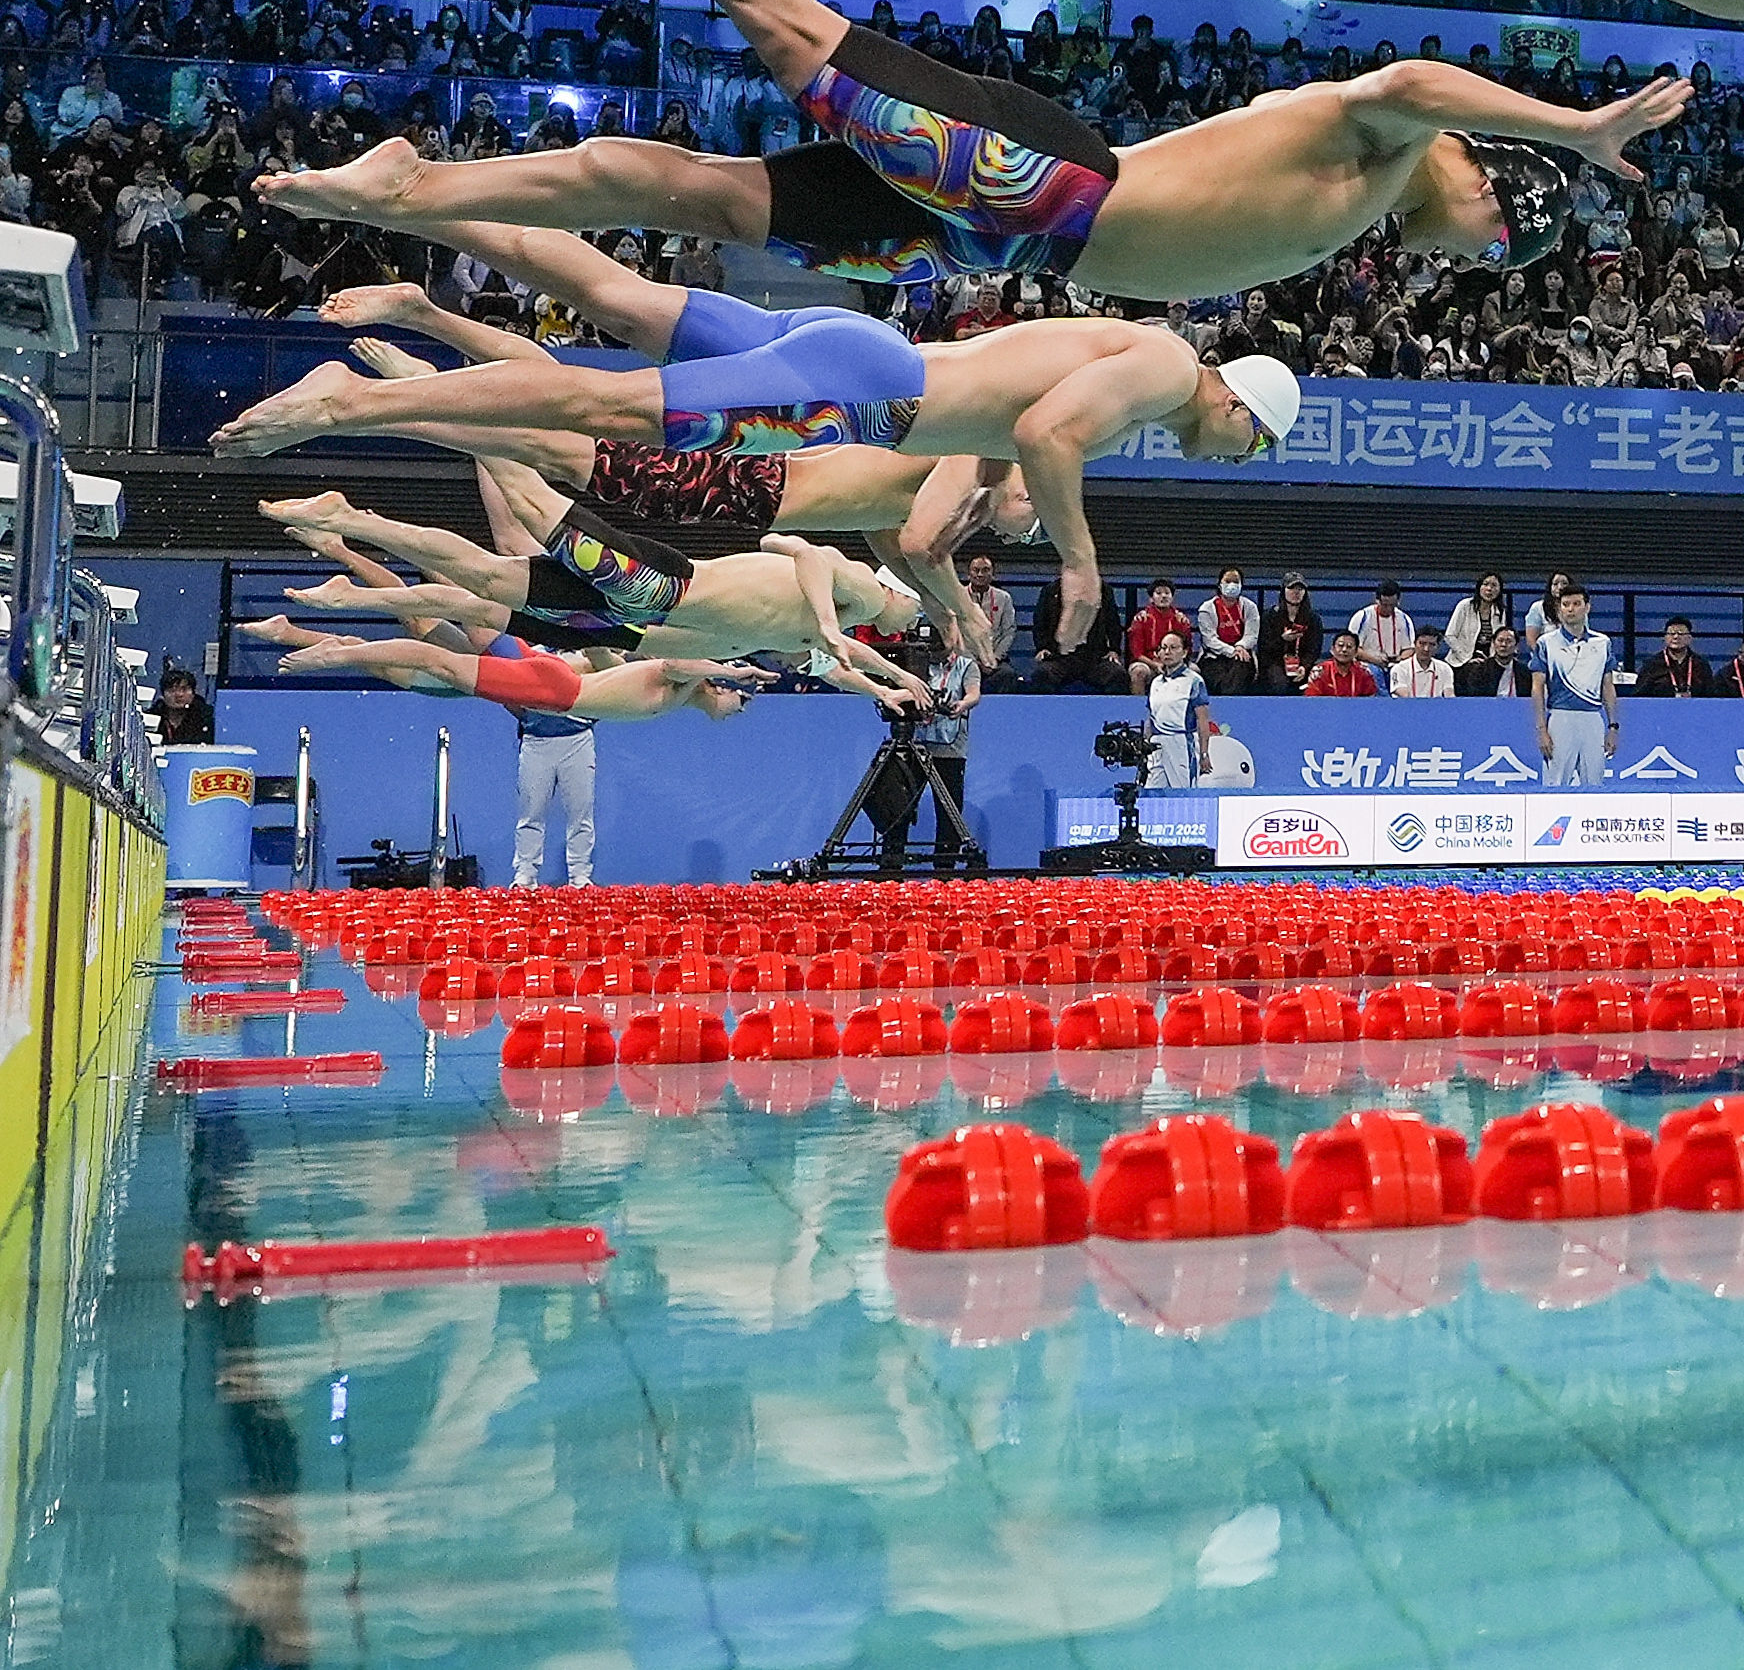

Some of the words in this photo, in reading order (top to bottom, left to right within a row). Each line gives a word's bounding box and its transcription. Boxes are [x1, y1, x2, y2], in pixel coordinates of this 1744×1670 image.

[1264, 818, 1318, 832] 百岁山
[1436, 814, 1513, 833] 中国移动
[1582, 818, 1664, 832] 中国南方航空
[1435, 837, 1470, 848] China
[1474, 836, 1512, 847] Mobile
